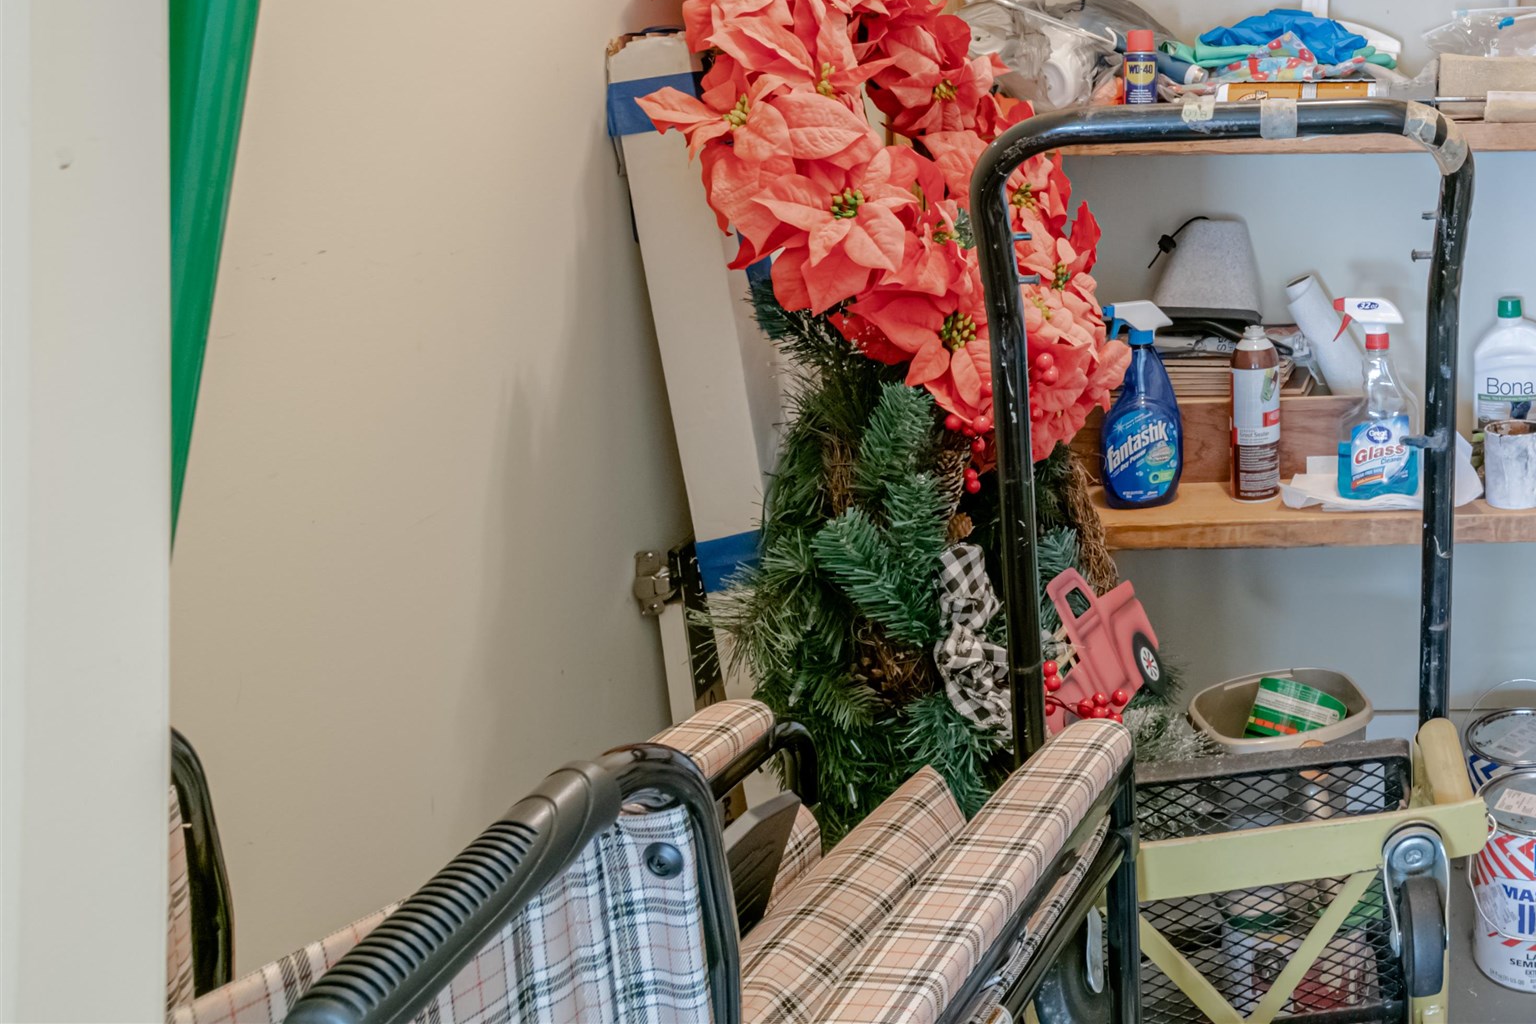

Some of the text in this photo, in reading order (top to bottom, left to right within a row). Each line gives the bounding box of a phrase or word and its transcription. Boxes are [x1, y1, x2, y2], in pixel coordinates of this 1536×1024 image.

[1128, 64, 1153, 75] WD-40
[1487, 377, 1534, 395] Bona
[1369, 428, 1388, 437] Great
[1107, 420, 1169, 474] fantastik
[1355, 445, 1405, 464] Glass
[1381, 457, 1402, 465] Cleaner
